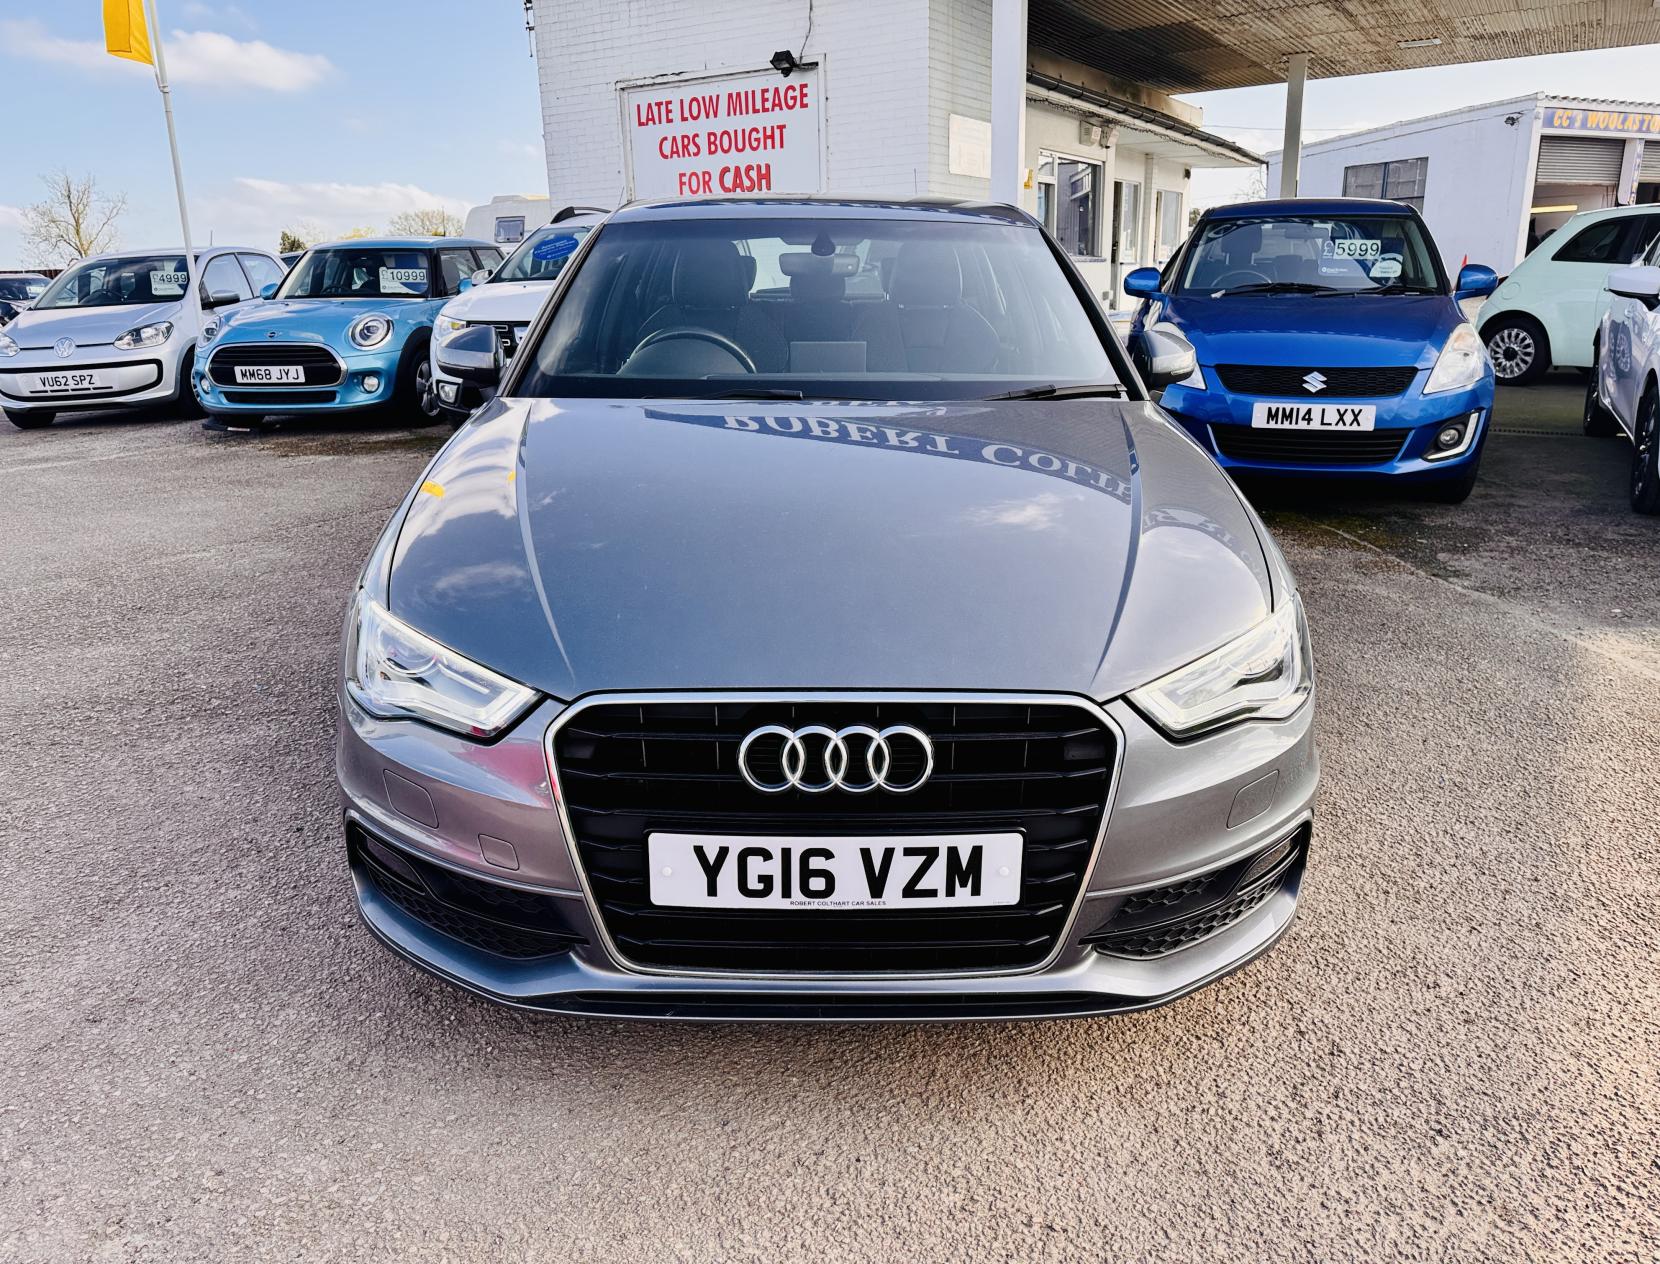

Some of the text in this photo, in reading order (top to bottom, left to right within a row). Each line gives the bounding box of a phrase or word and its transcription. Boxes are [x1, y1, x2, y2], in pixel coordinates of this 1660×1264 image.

[636, 83, 809, 127] LATE LOW MILEAGE
[658, 124, 787, 160] CARS BOUGHT
[678, 163, 772, 196] FOR CASH
[39, 374, 95, 388] VU62 SPZ
[240, 367, 301, 381] MM68 JYJ
[1265, 405, 1362, 427] MM14 LXX
[693, 845, 983, 899] YG16 VZM
